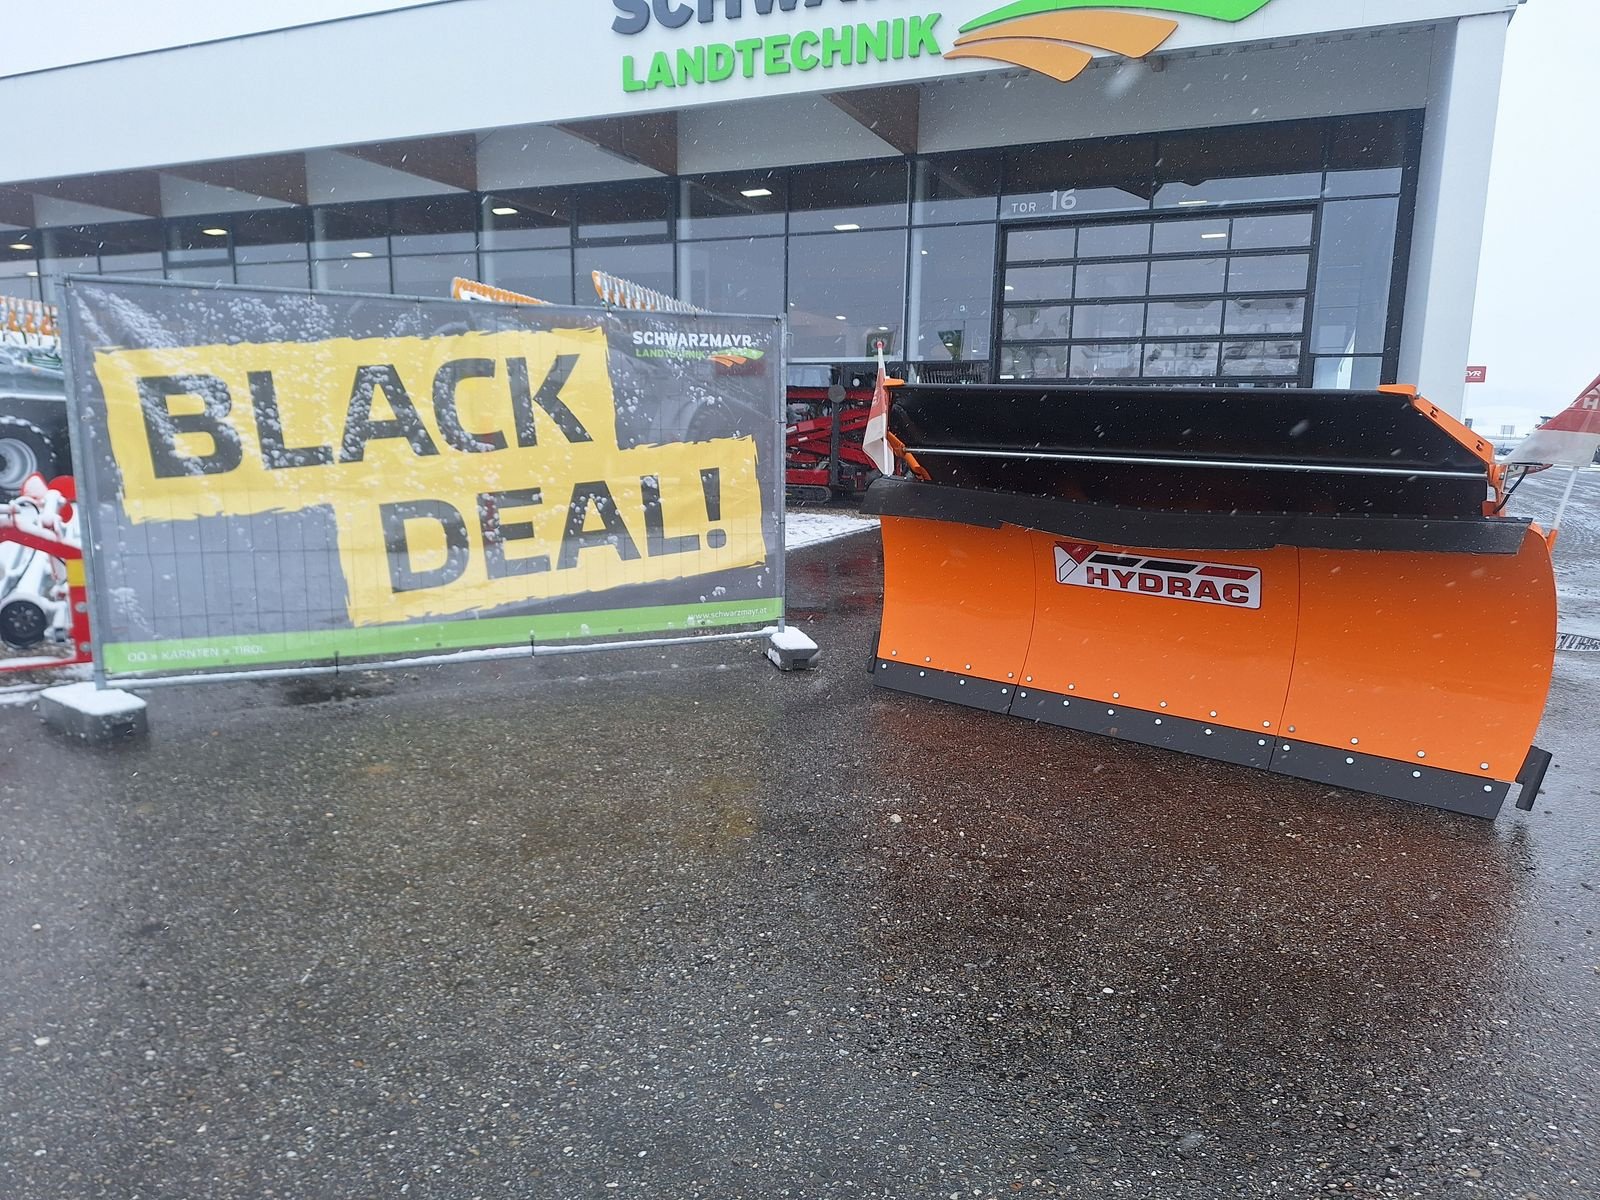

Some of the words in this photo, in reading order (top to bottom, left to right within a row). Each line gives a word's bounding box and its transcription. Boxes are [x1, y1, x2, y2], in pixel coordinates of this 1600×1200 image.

[622, 12, 943, 92] LANDTECHNIK
[1011, 202, 1037, 213] TOR
[1050, 188, 1077, 211] 16
[632, 331, 752, 347] SCHWARZMAYR
[136, 353, 594, 480] BLACK
[379, 467, 727, 594] DEAL!
[1086, 566, 1250, 604] HYDRAC
[688, 607, 768, 620] www.schwarzmayr.at
